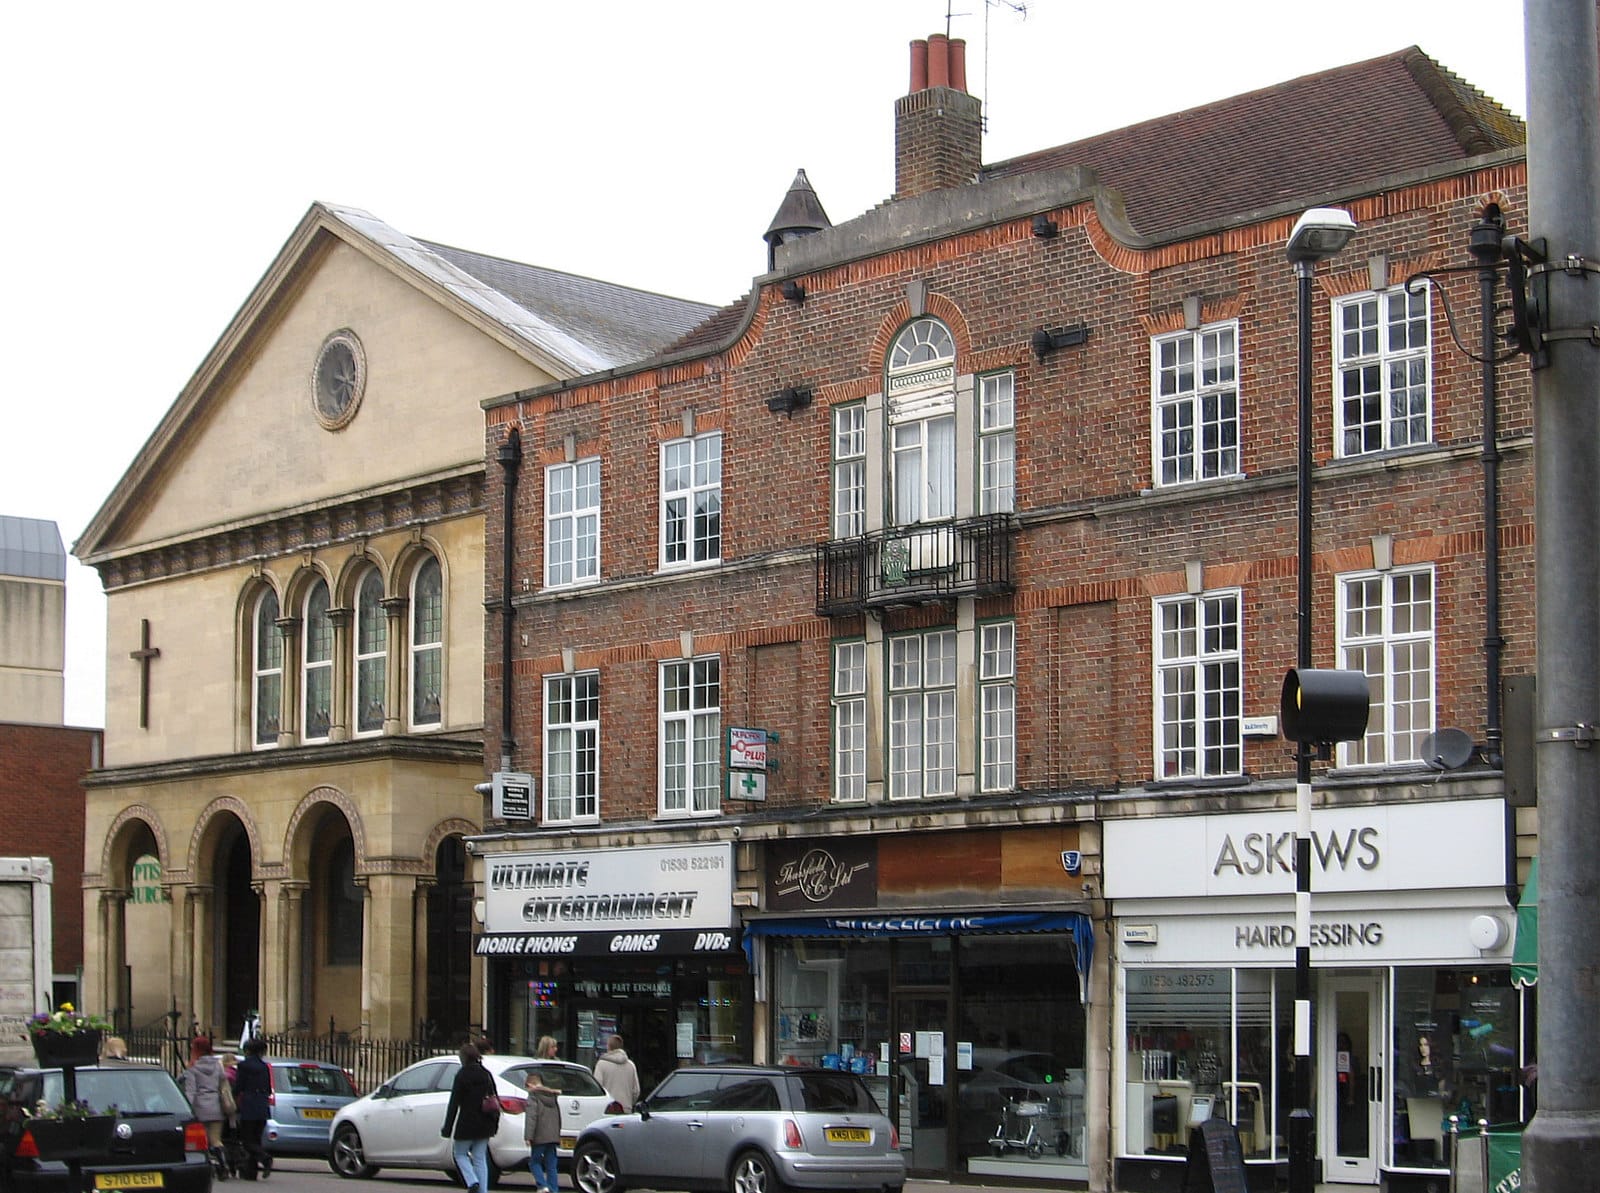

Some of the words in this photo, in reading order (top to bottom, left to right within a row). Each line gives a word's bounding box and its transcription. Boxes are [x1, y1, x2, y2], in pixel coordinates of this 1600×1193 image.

[744, 750, 766, 761] PLUS
[491, 861, 589, 890] ULTIMATE
[829, 862, 855, 892] Ltd
[522, 891, 698, 922] ENTERTAINMENT
[476, 937, 523, 954] MOBILE
[524, 936, 577, 952] PHONES
[610, 934, 661, 951] GAMES
[694, 933, 732, 950] DVDs
[1235, 922, 1383, 948] HAIRDESSING
[612, 982, 631, 992] PART
[633, 982, 672, 992] EXCHANGE
